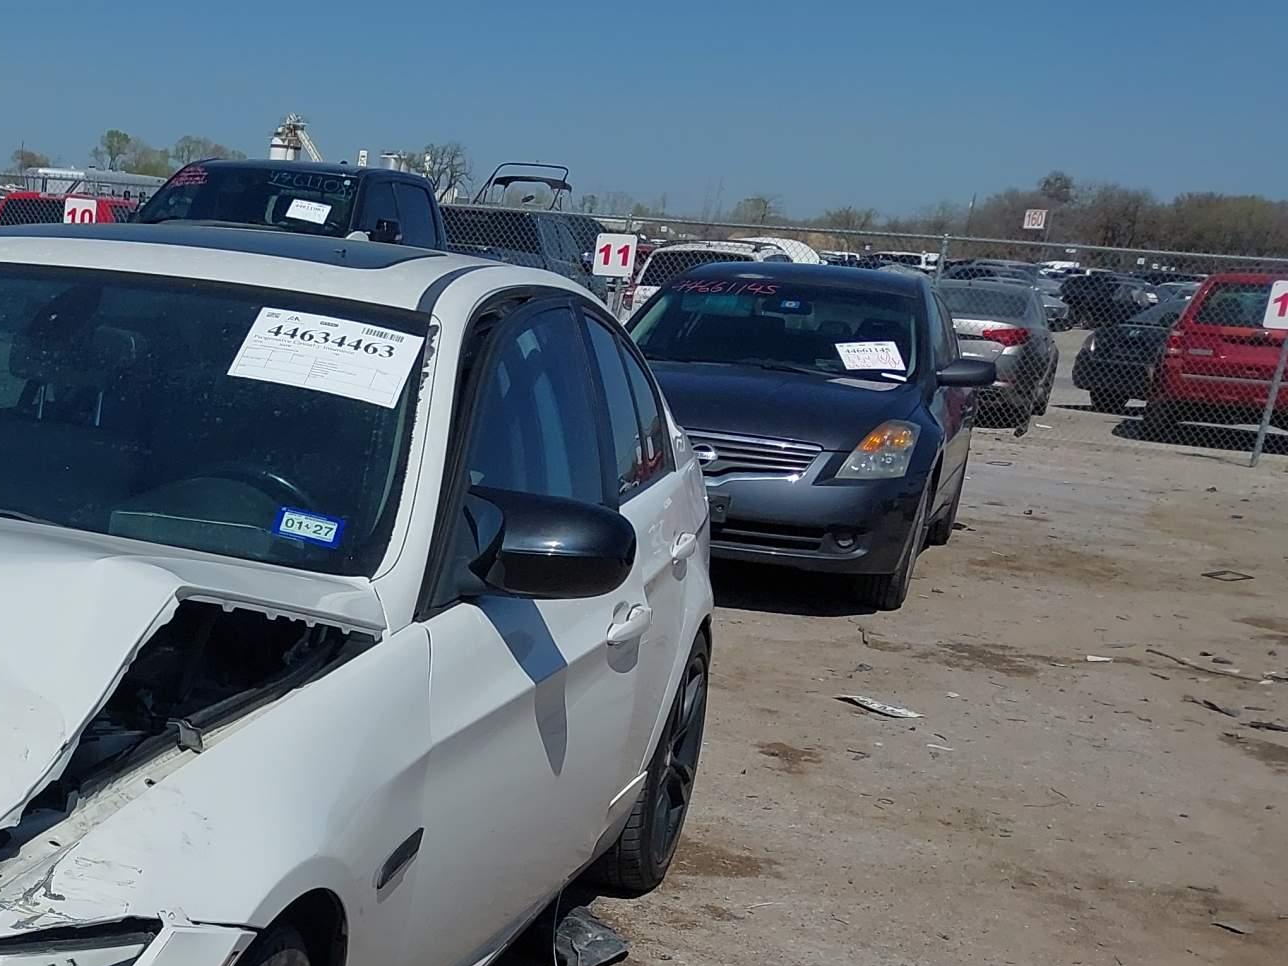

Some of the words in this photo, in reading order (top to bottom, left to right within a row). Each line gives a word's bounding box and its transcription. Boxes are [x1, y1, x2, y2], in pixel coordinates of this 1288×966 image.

[67, 207, 94, 224] 10
[1027, 211, 1044, 227] 160
[598, 243, 631, 267] 11
[267, 324, 396, 358] 44634463
[284, 517, 304, 531] 01
[312, 524, 334, 537] 27
